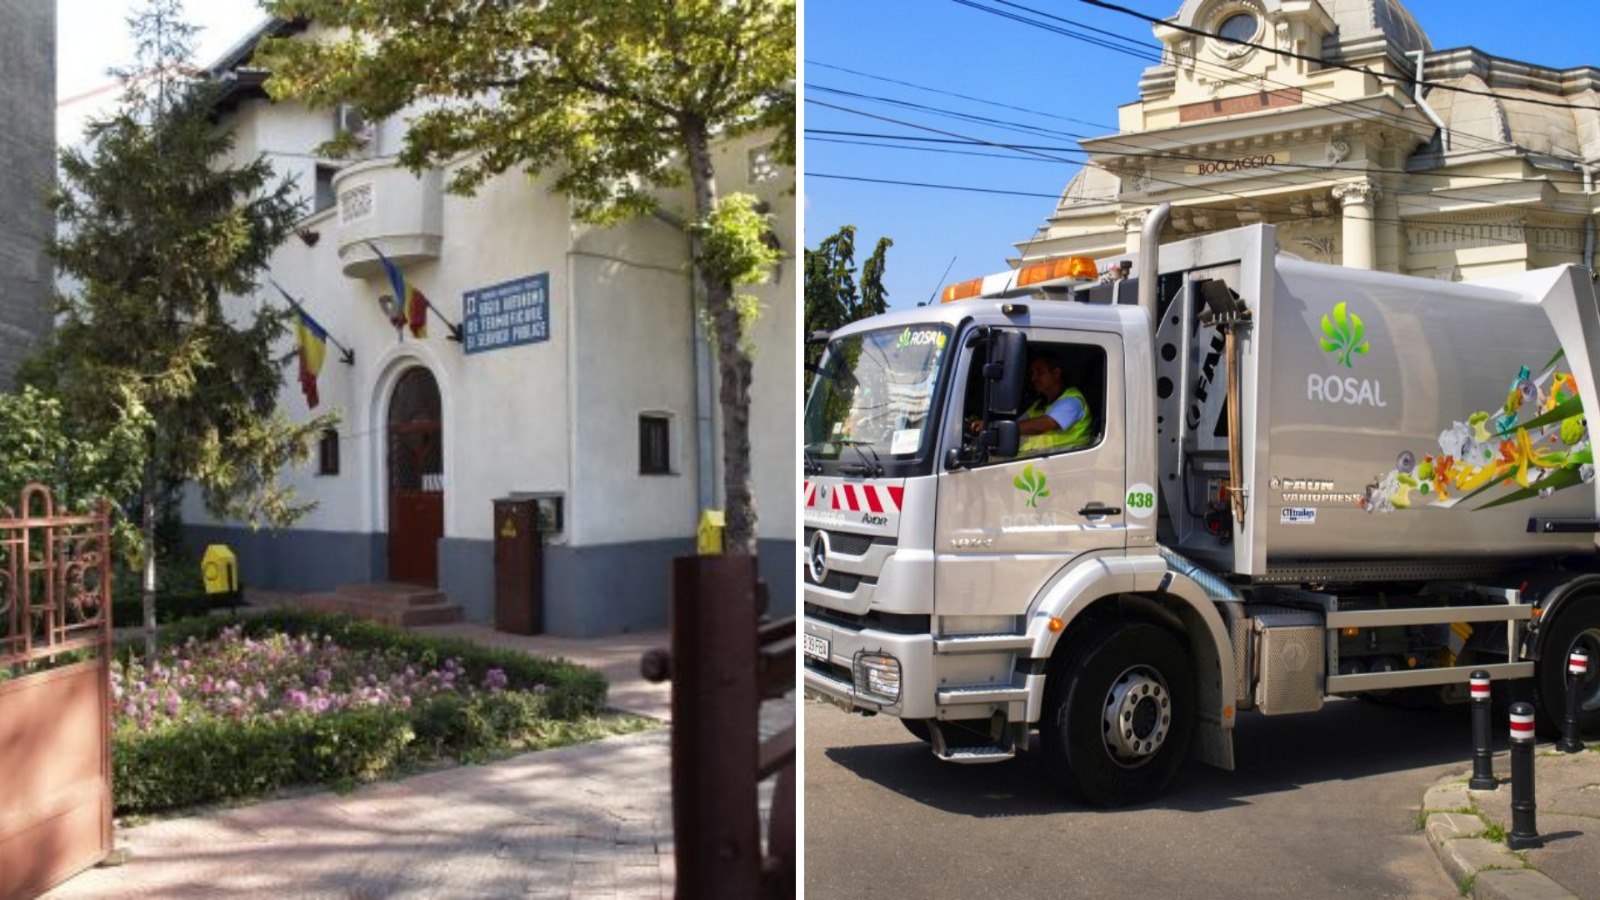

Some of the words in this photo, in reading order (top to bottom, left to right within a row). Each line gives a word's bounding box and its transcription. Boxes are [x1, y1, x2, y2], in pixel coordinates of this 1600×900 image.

[1307, 373, 1387, 408] ROSAL
[1282, 478, 1335, 491] FAUN
[1127, 492, 1153, 508] 438
